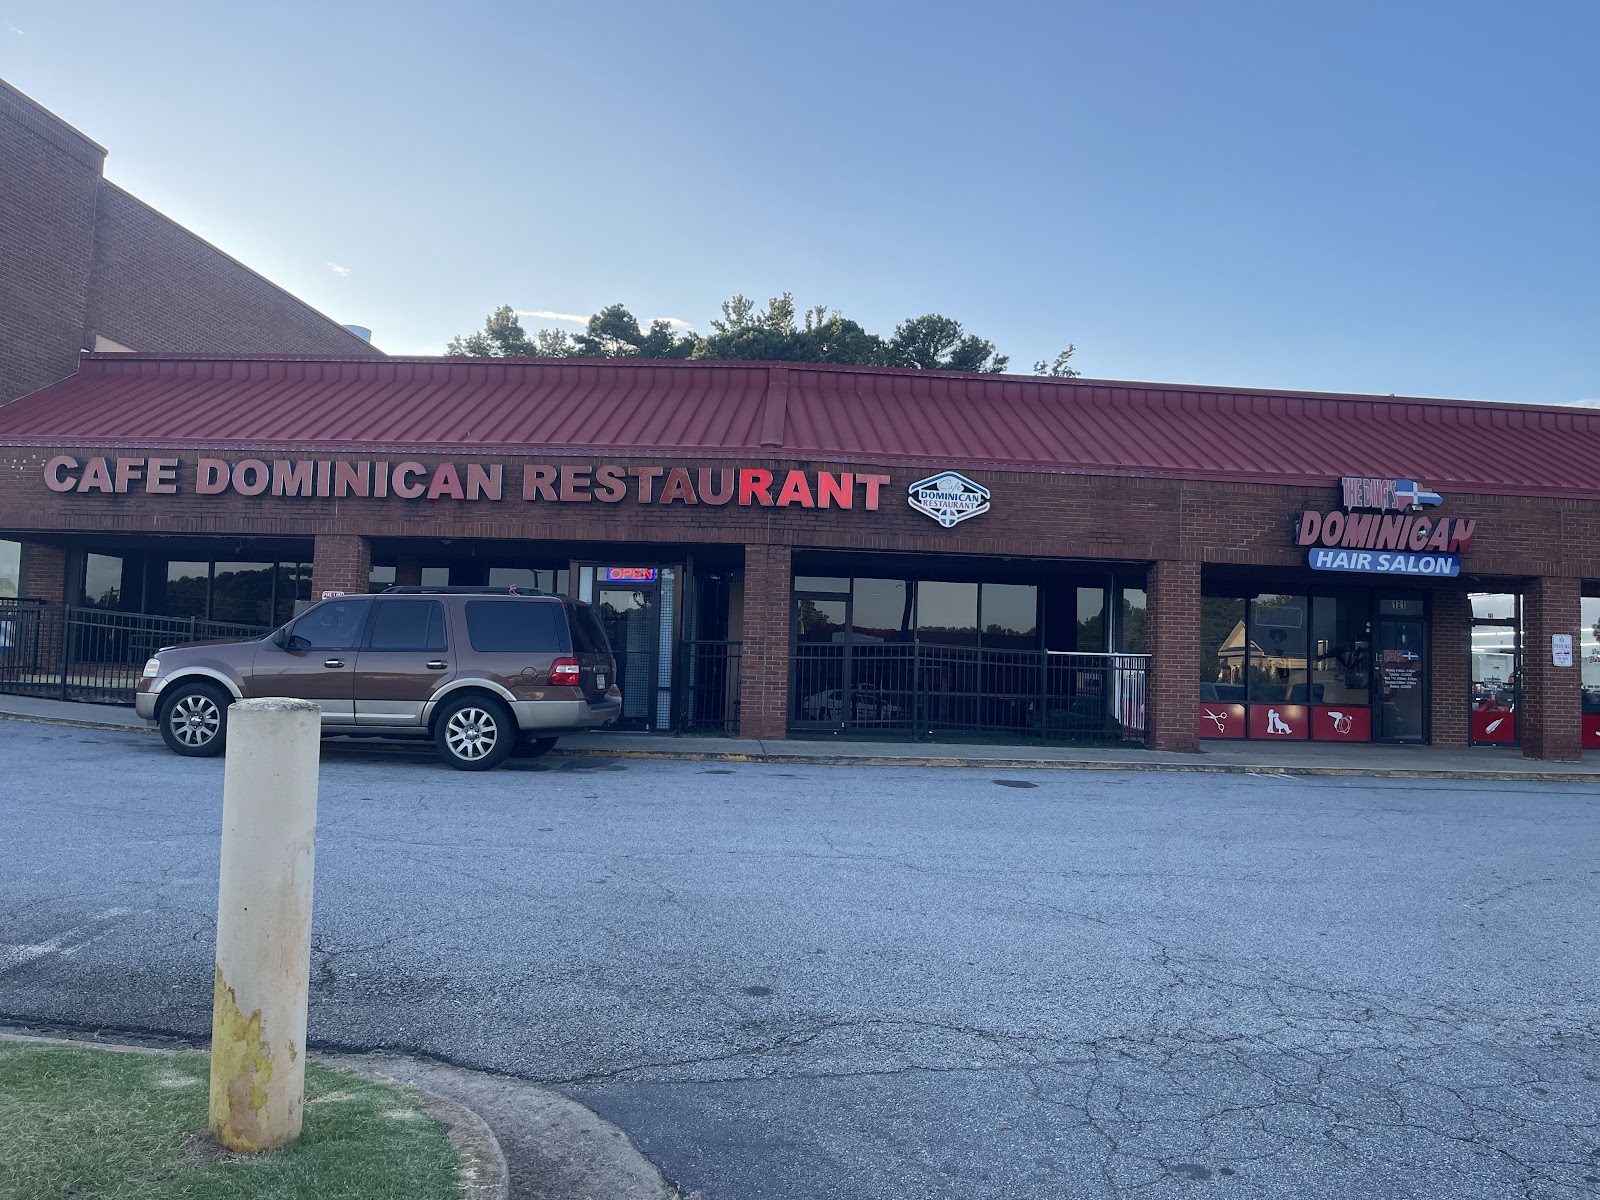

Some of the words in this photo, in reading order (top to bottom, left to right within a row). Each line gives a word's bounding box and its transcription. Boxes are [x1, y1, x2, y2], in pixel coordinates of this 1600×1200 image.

[43, 455, 178, 493] CAFE
[195, 458, 502, 500] DOMINICAN
[522, 463, 891, 511] RESTAURANT
[939, 478, 963, 493] Cafe
[920, 491, 980, 503] DOMINICAN
[1342, 477, 1363, 508] THE
[922, 499, 976, 510] RESTAURANT
[1298, 510, 1477, 553] DOMINICAN
[1316, 551, 1372, 570] HAIR
[1376, 554, 1453, 574] SALON
[609, 567, 654, 580] OPEN
[1393, 600, 1405, 609] 121
